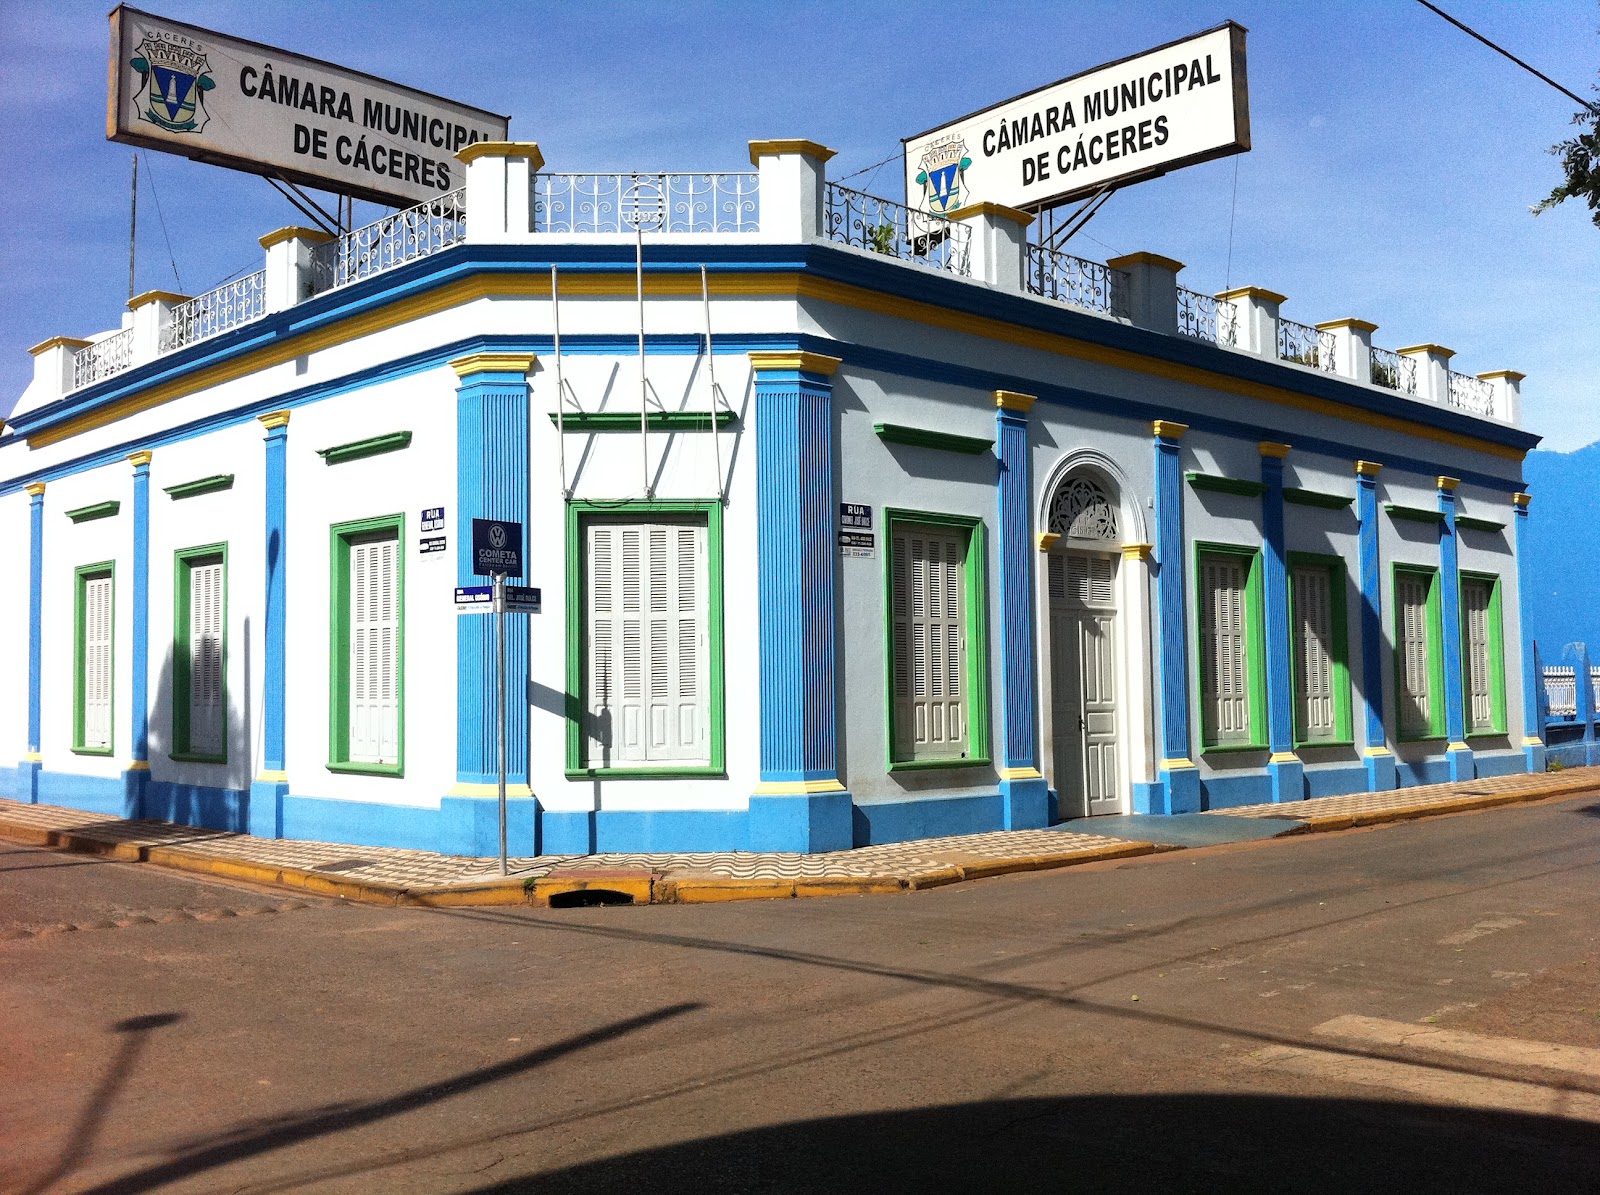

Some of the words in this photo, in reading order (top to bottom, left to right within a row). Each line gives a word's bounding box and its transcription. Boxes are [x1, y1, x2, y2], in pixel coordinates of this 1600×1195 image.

[240, 63, 354, 122] CÂMARA
[363, 98, 489, 153] MUNICIPA
[983, 101, 1076, 157] CÂMARA
[1083, 54, 1221, 124] MUNICIPAL
[294, 124, 328, 160] DE
[336, 132, 451, 191] CÁCERES
[1022, 151, 1050, 186] DE
[1057, 114, 1170, 174] CÁCERES
[426, 509, 439, 519] RUA
[847, 505, 865, 515] RUA
[479, 549, 517, 559] COMETA
